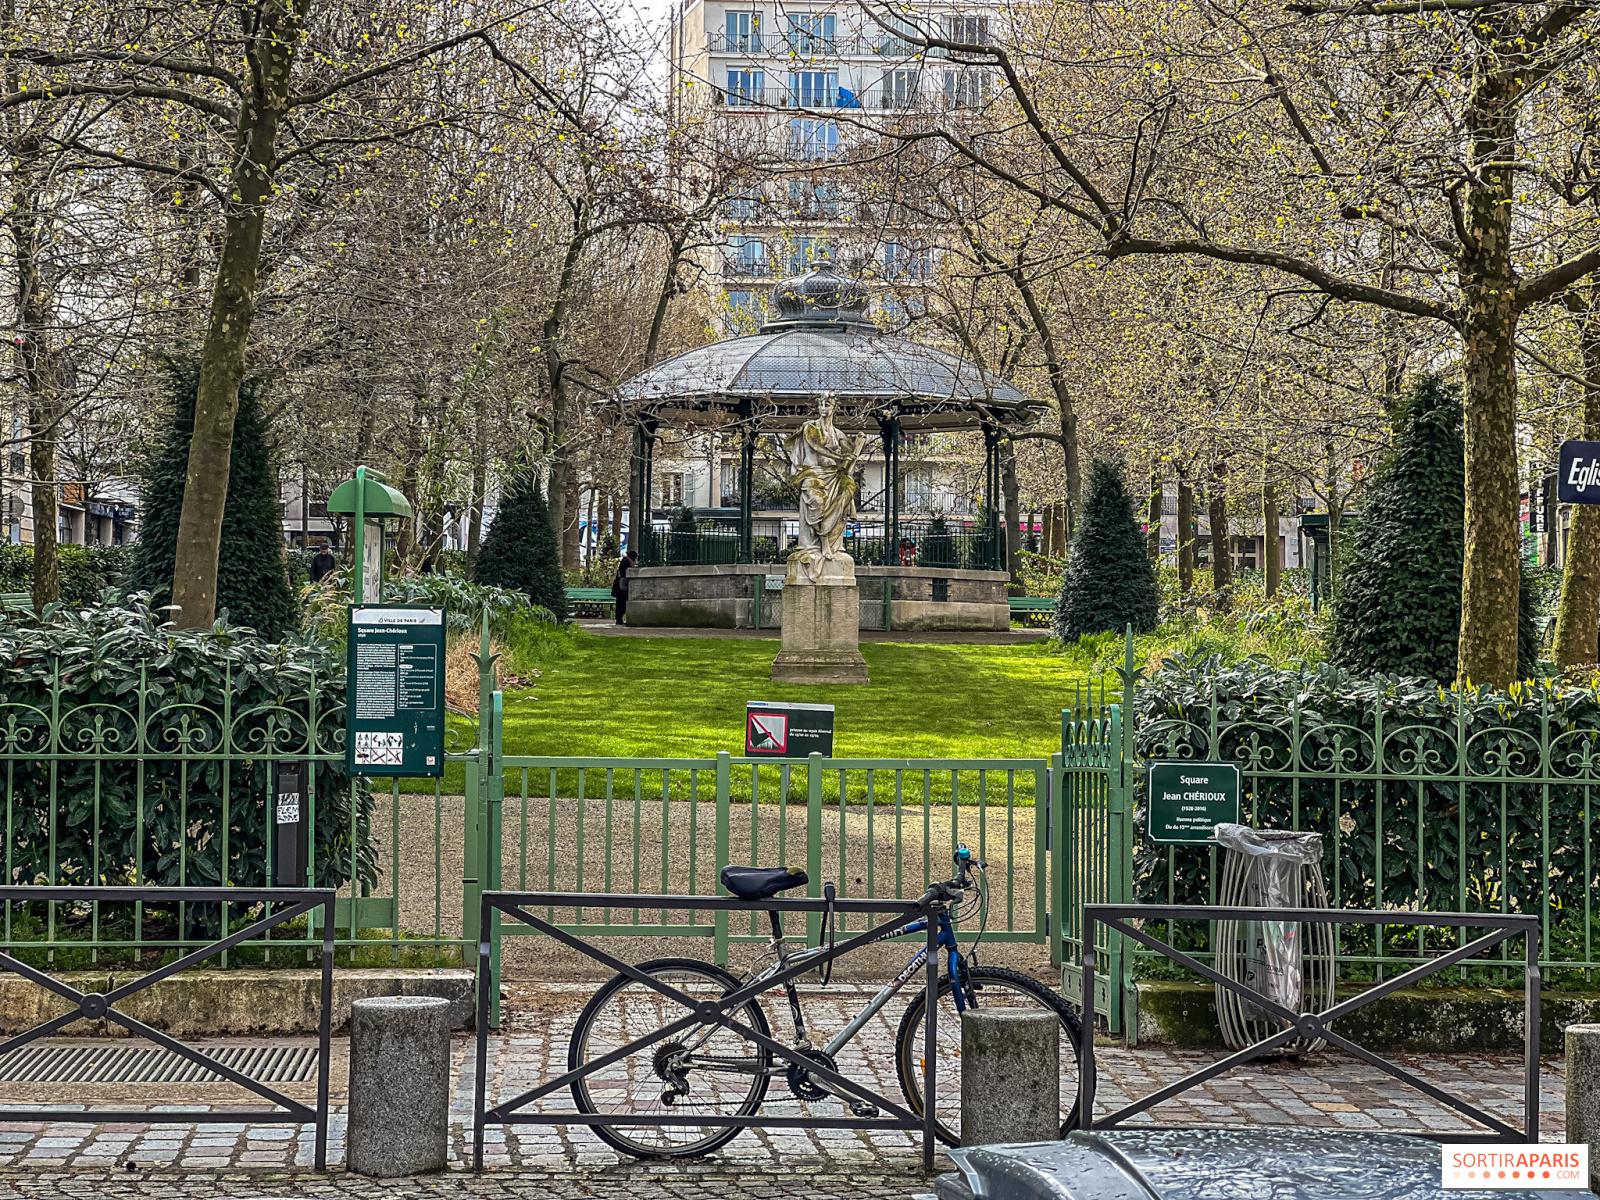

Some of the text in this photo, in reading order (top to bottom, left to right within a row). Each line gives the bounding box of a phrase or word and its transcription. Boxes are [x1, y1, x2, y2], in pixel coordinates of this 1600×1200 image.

[1179, 774, 1209, 786] Square
[1162, 790, 1226, 801] Jean CHÉRIOUX
[898, 948, 928, 983] DECATH
